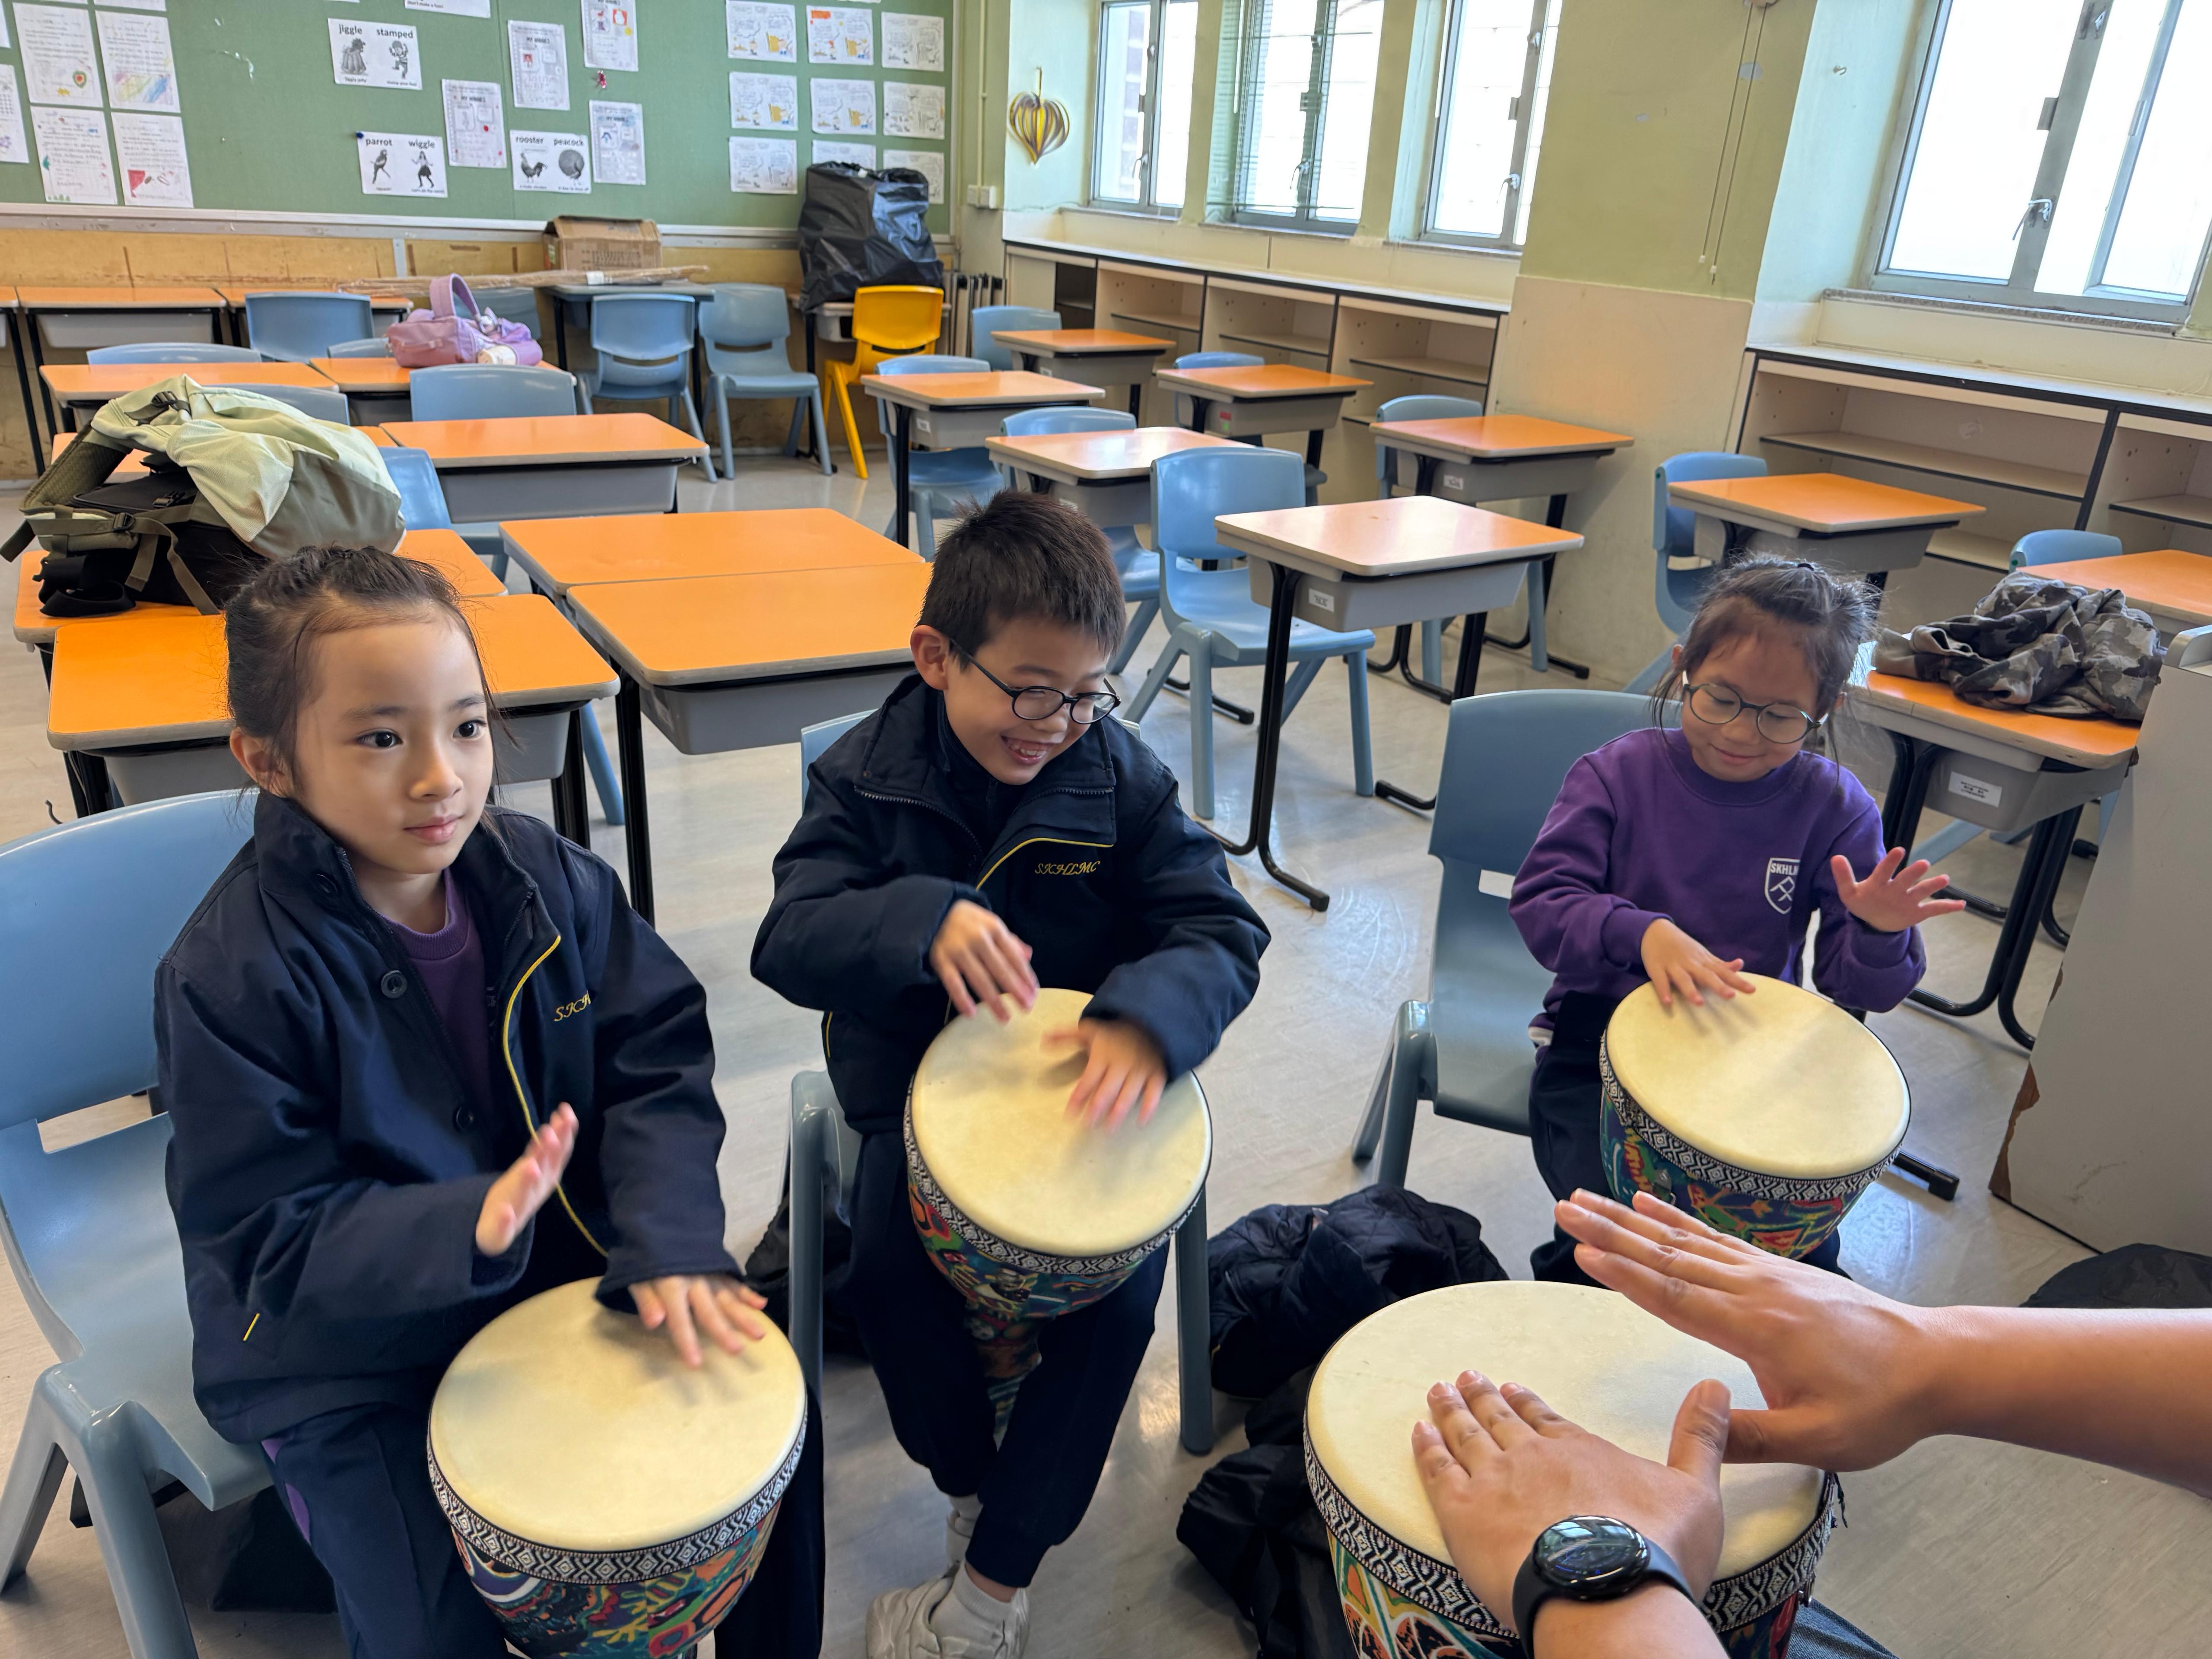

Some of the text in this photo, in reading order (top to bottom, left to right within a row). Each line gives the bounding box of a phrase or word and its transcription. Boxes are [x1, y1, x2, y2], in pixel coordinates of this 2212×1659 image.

[339, 24, 413, 38] jiggle stamped
[408, 139, 435, 149] wiggle
